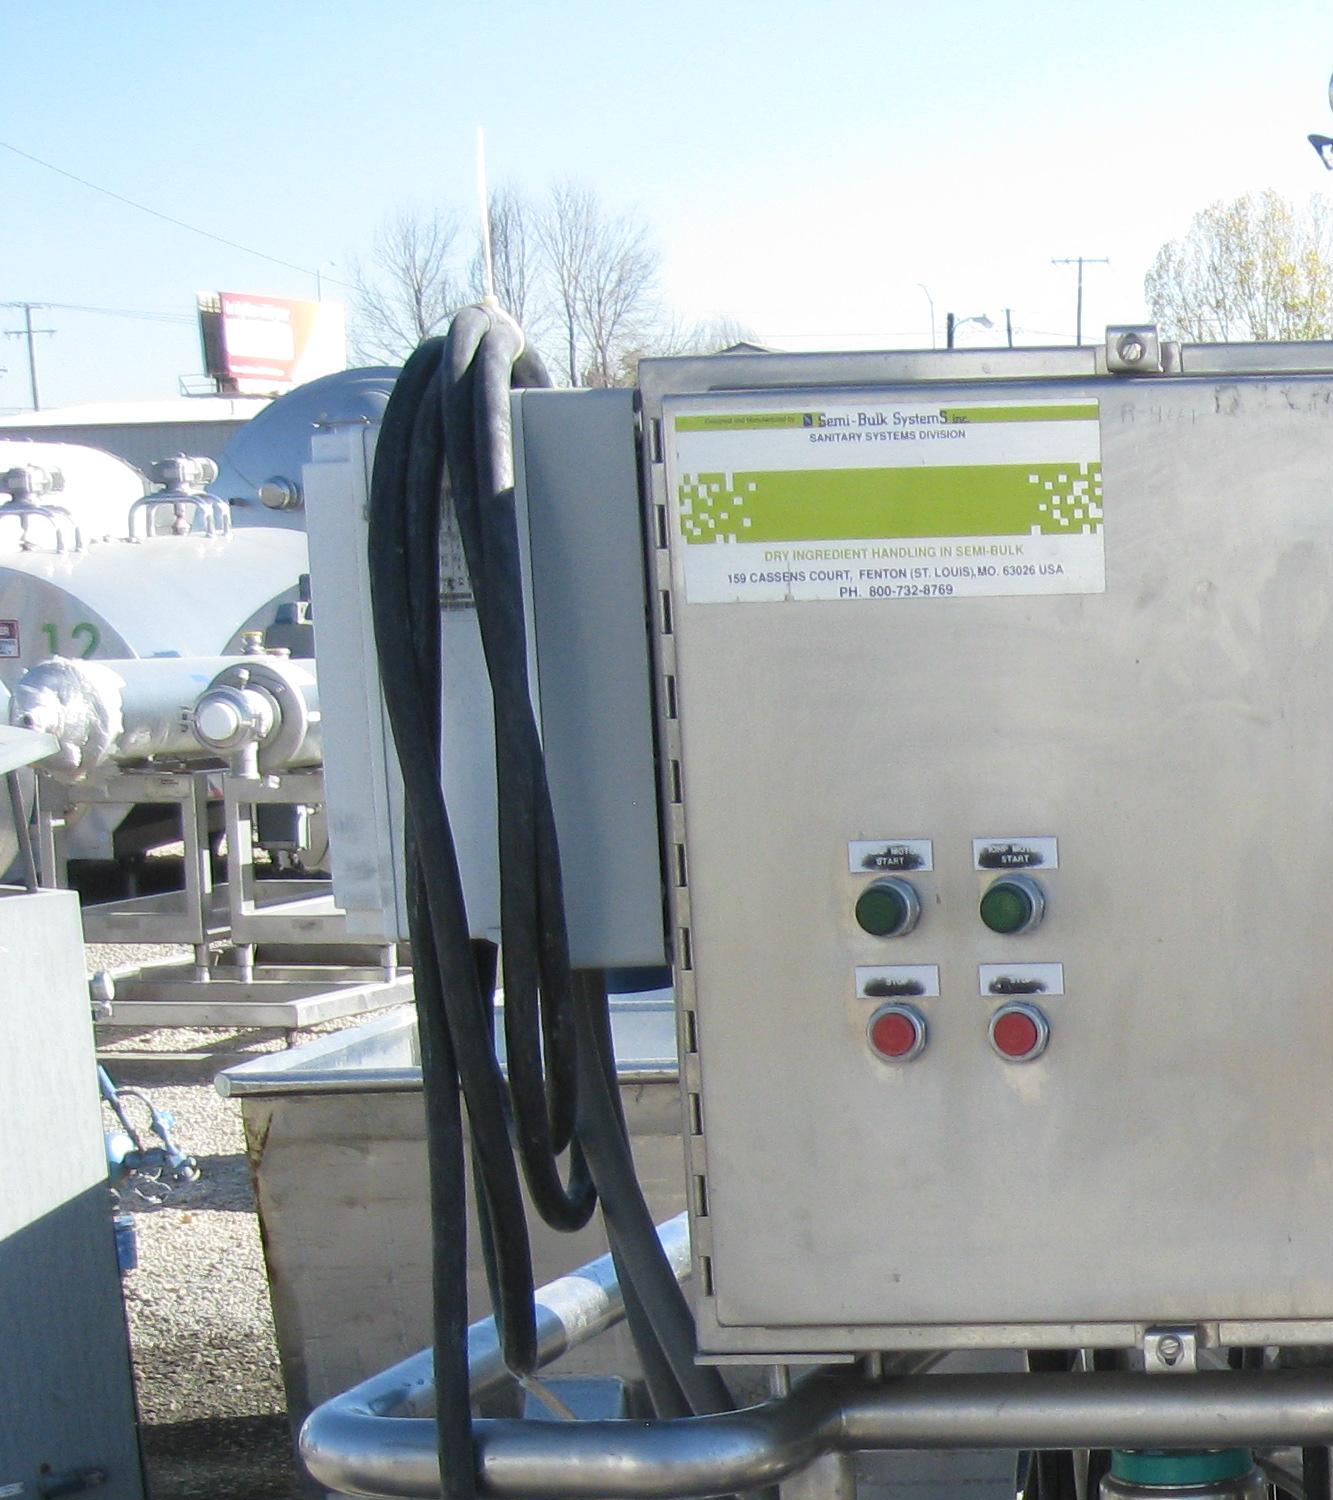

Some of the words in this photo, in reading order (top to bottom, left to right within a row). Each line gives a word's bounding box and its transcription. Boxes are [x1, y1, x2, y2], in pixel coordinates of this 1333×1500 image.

[810, 431, 862, 443] SANITARY
[866, 430, 916, 441] SYSTEMS
[919, 429, 966, 440] DIVISION
[764, 550, 790, 562] DRY
[793, 549, 867, 561] INGREDIENT
[872, 546, 936, 559] HANDLING
[940, 546, 952, 557] IN
[956, 544, 1024, 557] SEMI-BULK
[727, 573, 747, 584] 159
[750, 570, 806, 583] CASSENS
[809, 569, 854, 582] COURT,
[859, 568, 907, 580] FENTON
[910, 567, 932, 580] (ST.
[1003, 564, 1035, 576] 63026
[1039, 563, 1064, 575] USA
[840, 586, 862, 598] PH.
[869, 583, 953, 597] 800-732-8769
[41, 622, 101, 660] 12
[876, 856, 905, 866] START
[1001, 854, 1029, 864] START
